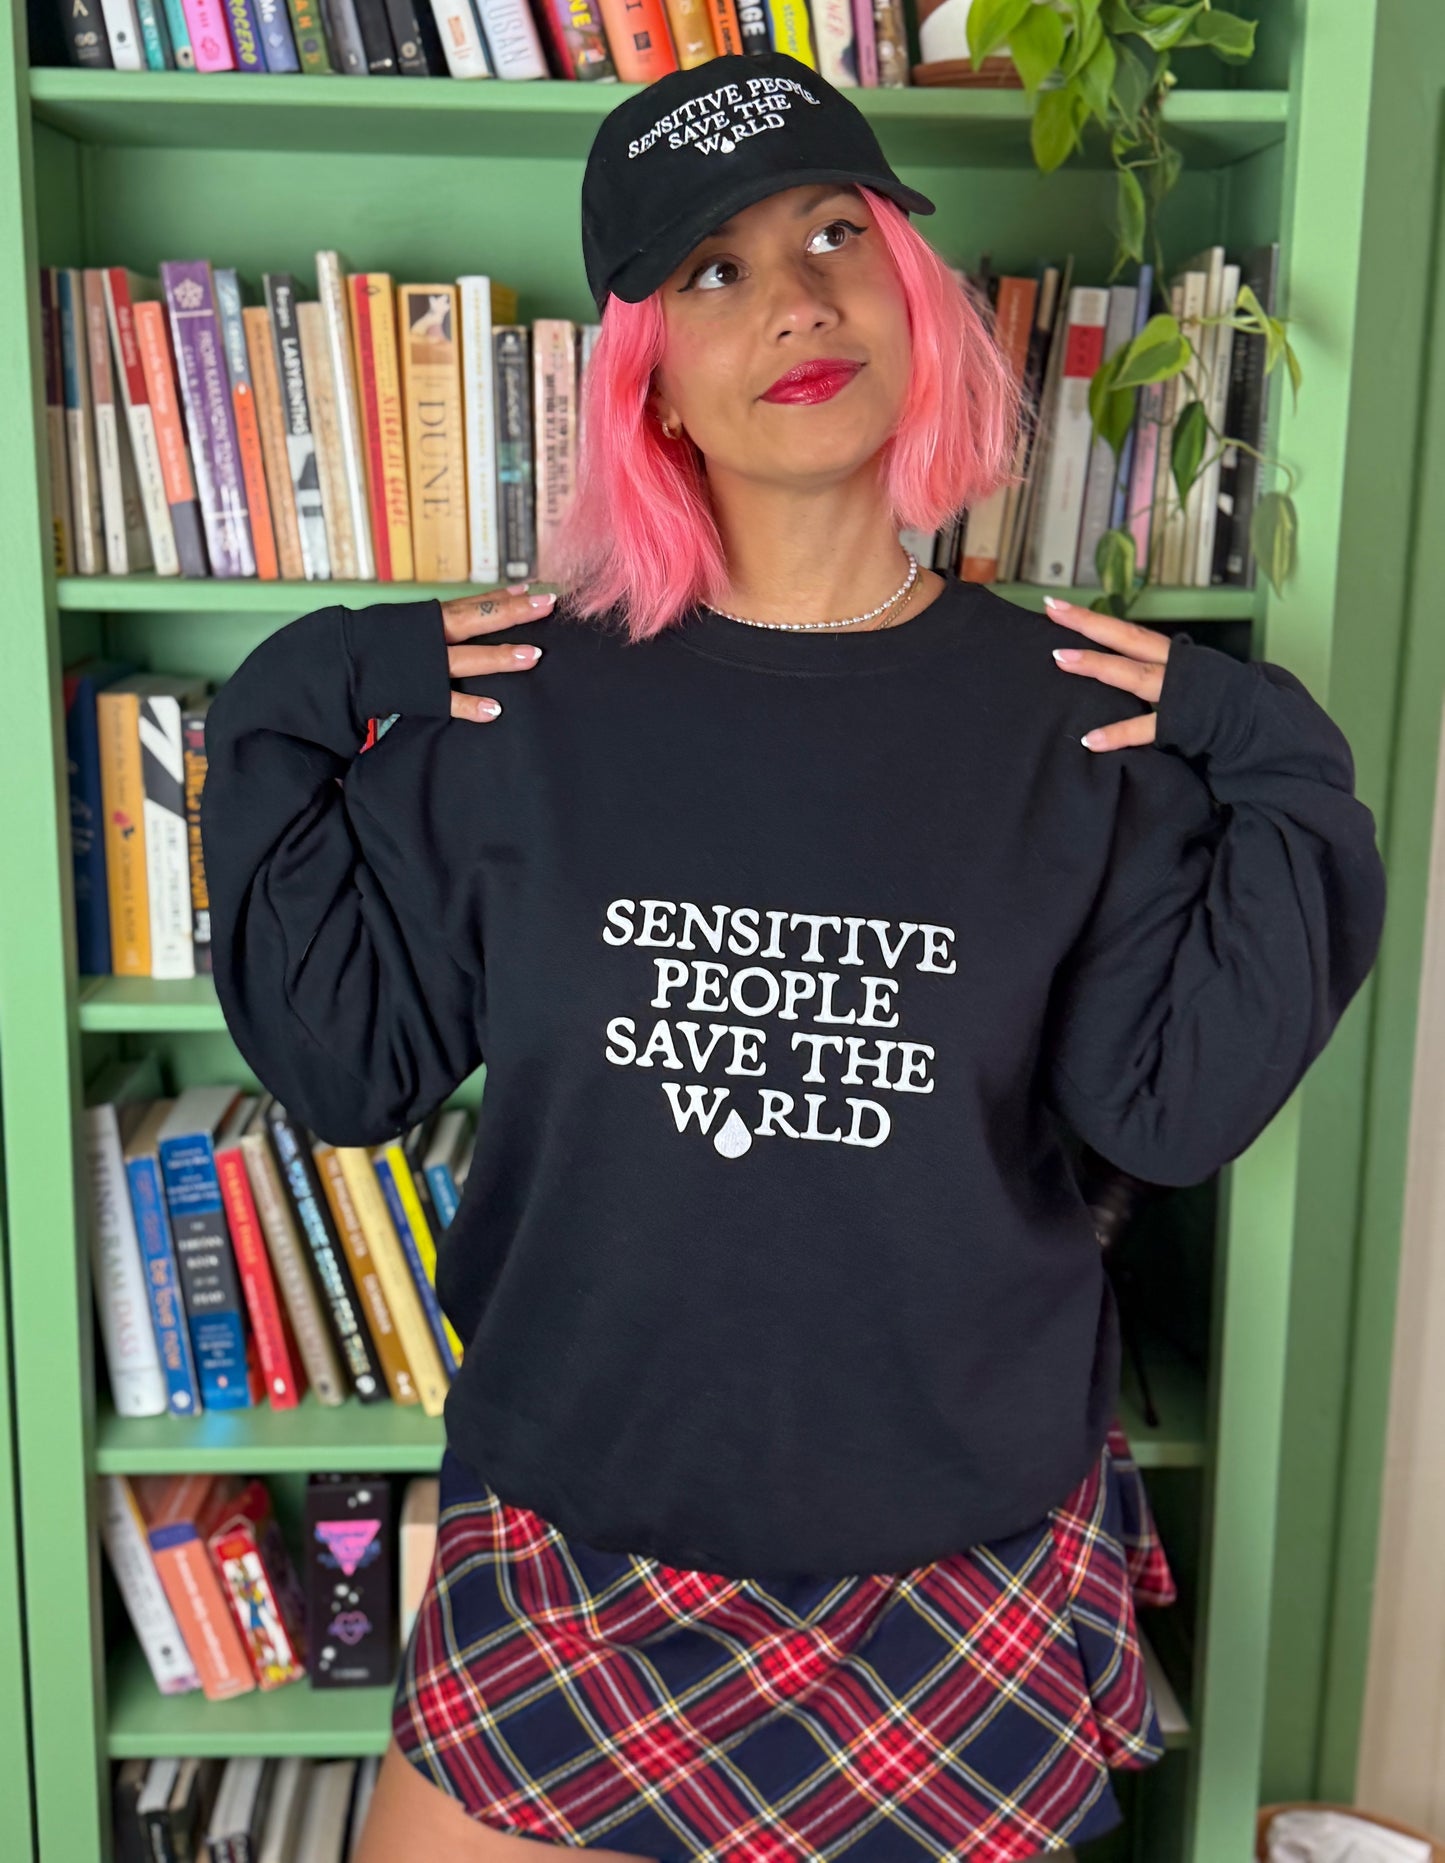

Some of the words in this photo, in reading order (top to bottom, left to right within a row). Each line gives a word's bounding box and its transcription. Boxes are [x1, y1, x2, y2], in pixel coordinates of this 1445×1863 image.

[628, 84, 743, 159] SENSITIVE
[746, 77, 821, 105] PEOPLE
[668, 111, 730, 150] SAVE
[733, 94, 792, 120] THE
[274, 285, 292, 329] Borges
[282, 335, 309, 434] LABYRINTHS
[418, 400, 450, 519] DUNE
[602, 898, 957, 975] SENSITIVE
[650, 957, 900, 1029] PEOPLE
[604, 1016, 768, 1078] SAVE
[791, 1031, 936, 1094] THE
[149, 1257, 169, 1286] be
[154, 1287, 177, 1329] love
[161, 1330, 183, 1370] now
